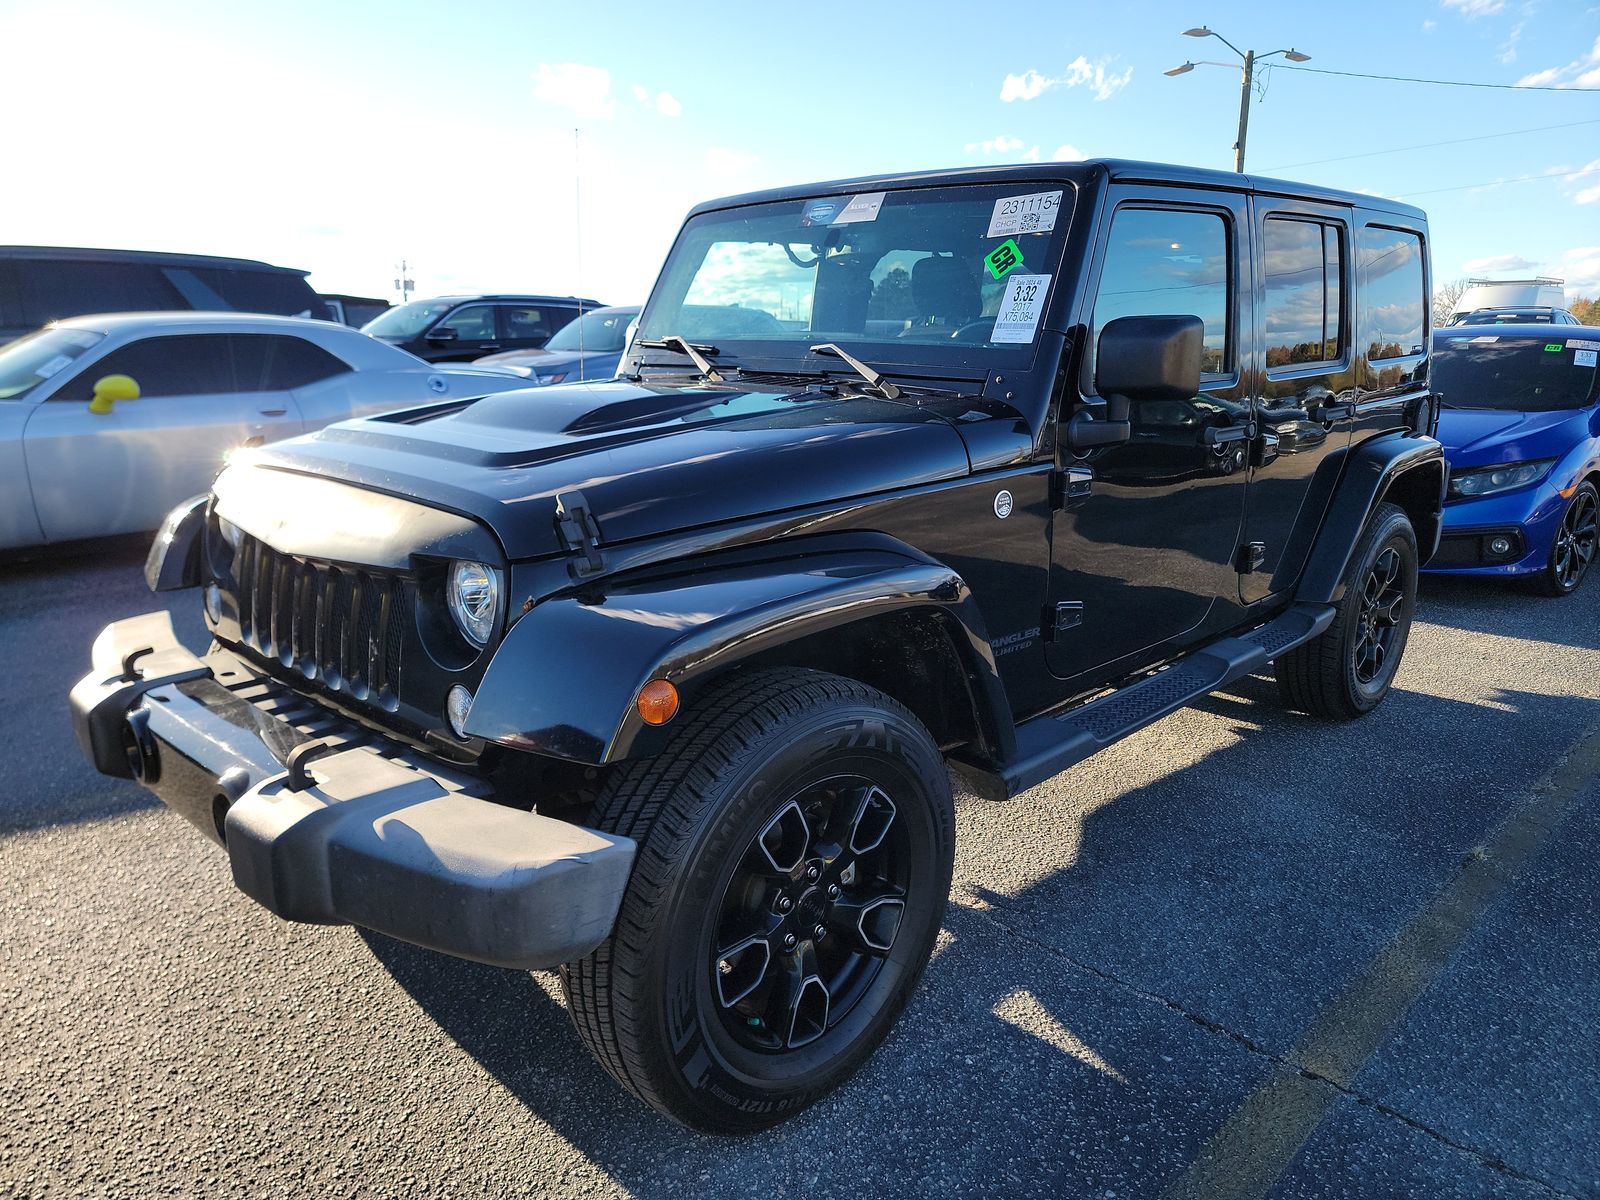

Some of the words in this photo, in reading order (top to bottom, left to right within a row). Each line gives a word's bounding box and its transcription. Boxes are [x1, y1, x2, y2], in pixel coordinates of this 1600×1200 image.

[1001, 194, 1061, 215] 2311154
[995, 219, 1017, 228] CHCP
[991, 246, 1016, 274] CR
[1013, 285, 1037, 302] 3:32
[1012, 302, 1032, 311] 2017
[1003, 311, 1034, 322] X75,084
[989, 627, 1041, 648] ANGLER
[993, 640, 1033, 656] LIMITED
